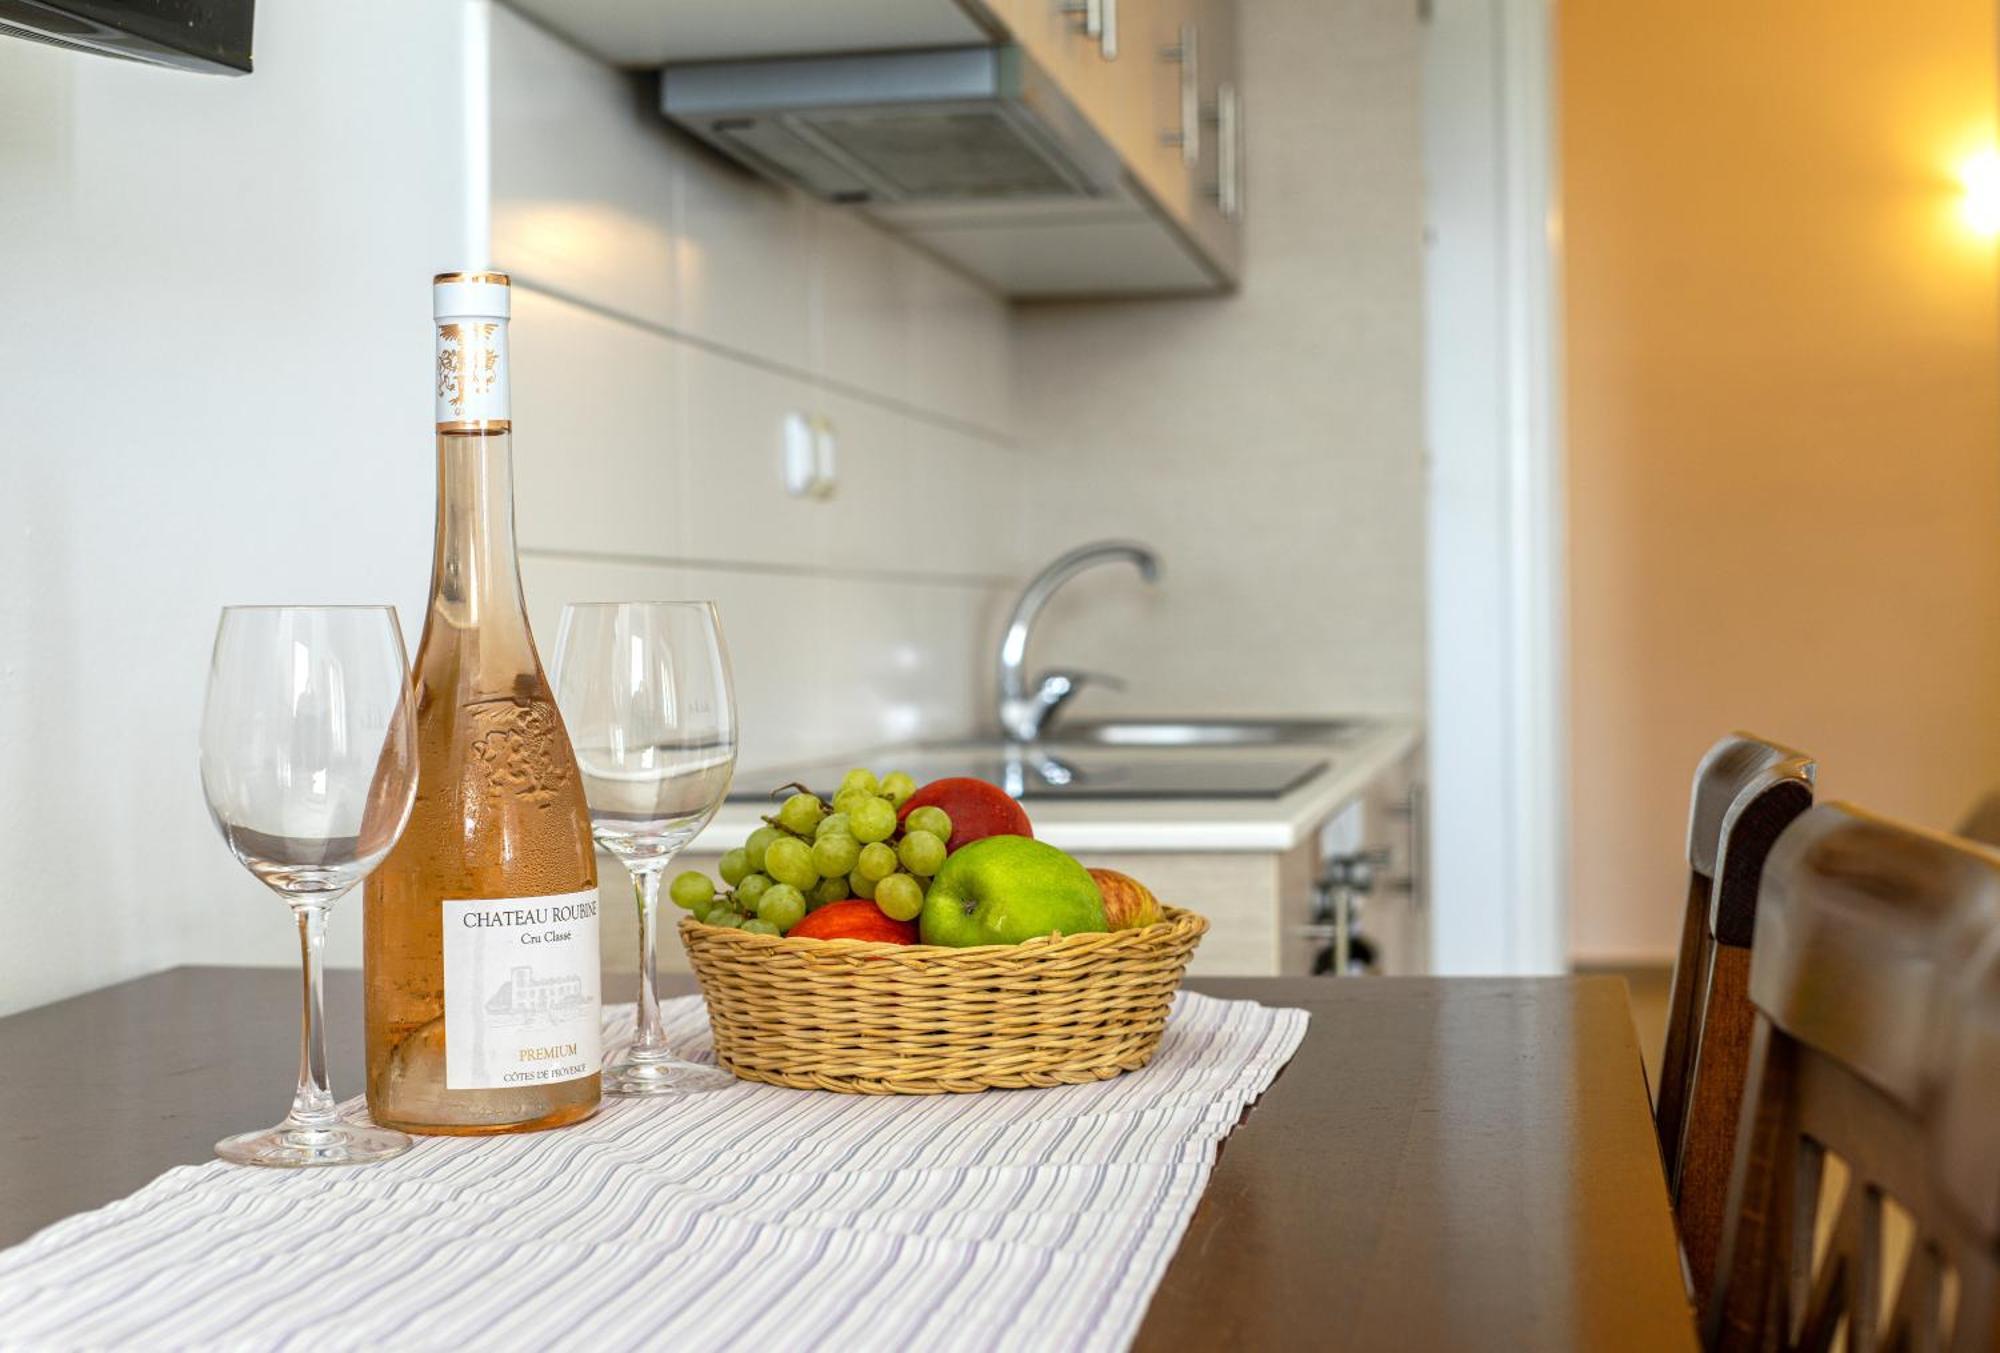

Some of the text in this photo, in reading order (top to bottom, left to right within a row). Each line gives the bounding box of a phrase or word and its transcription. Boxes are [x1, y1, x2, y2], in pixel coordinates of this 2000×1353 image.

[463, 900, 597, 928] CHATEAU ROUBINE
[520, 932, 541, 945] Cru
[519, 1043, 577, 1062] PREMIUM
[503, 1071, 536, 1082] CÔTES
[536, 1070, 549, 1079] DE
